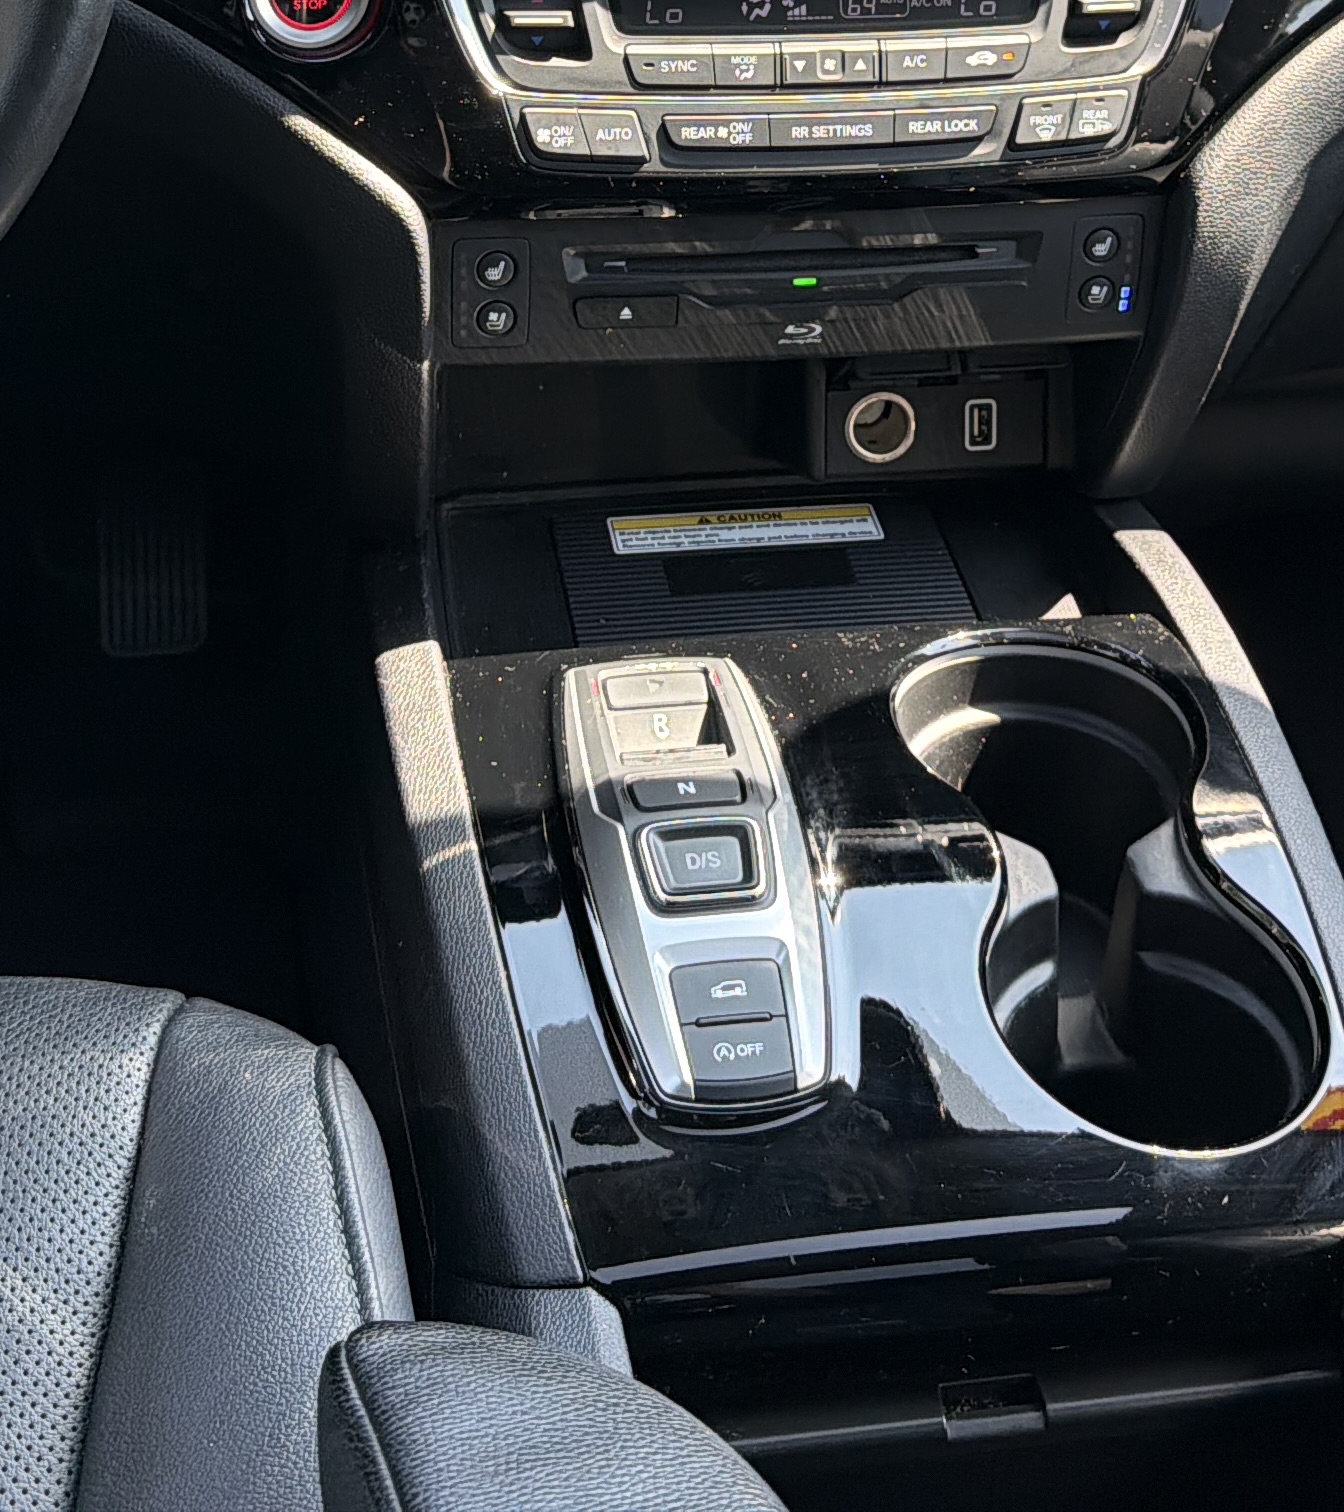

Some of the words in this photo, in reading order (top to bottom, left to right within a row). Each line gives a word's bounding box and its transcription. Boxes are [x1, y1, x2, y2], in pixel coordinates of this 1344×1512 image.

[293, 0, 327, 10] STOP
[660, 59, 697, 73] SYNC
[730, 55, 758, 65] MODE
[903, 55, 927, 69] A/C
[1030, 114, 1063, 126] FRONT
[1083, 109, 1109, 120] REAR
[551, 125, 574, 137] ON/
[729, 122, 752, 133] ON/
[792, 126, 809, 138] RR
[811, 124, 873, 138] SETTINGS
[908, 121, 942, 134] REAR
[944, 118, 978, 132] LOCK
[596, 128, 632, 141] AUTO
[681, 127, 715, 140] REAR
[729, 133, 753, 145] OFF
[552, 136, 574, 147] OFF
[717, 512, 783, 523] CAUTION
[677, 781, 696, 795] N
[685, 851, 721, 870] D/S
[737, 1043, 764, 1056] OFF
